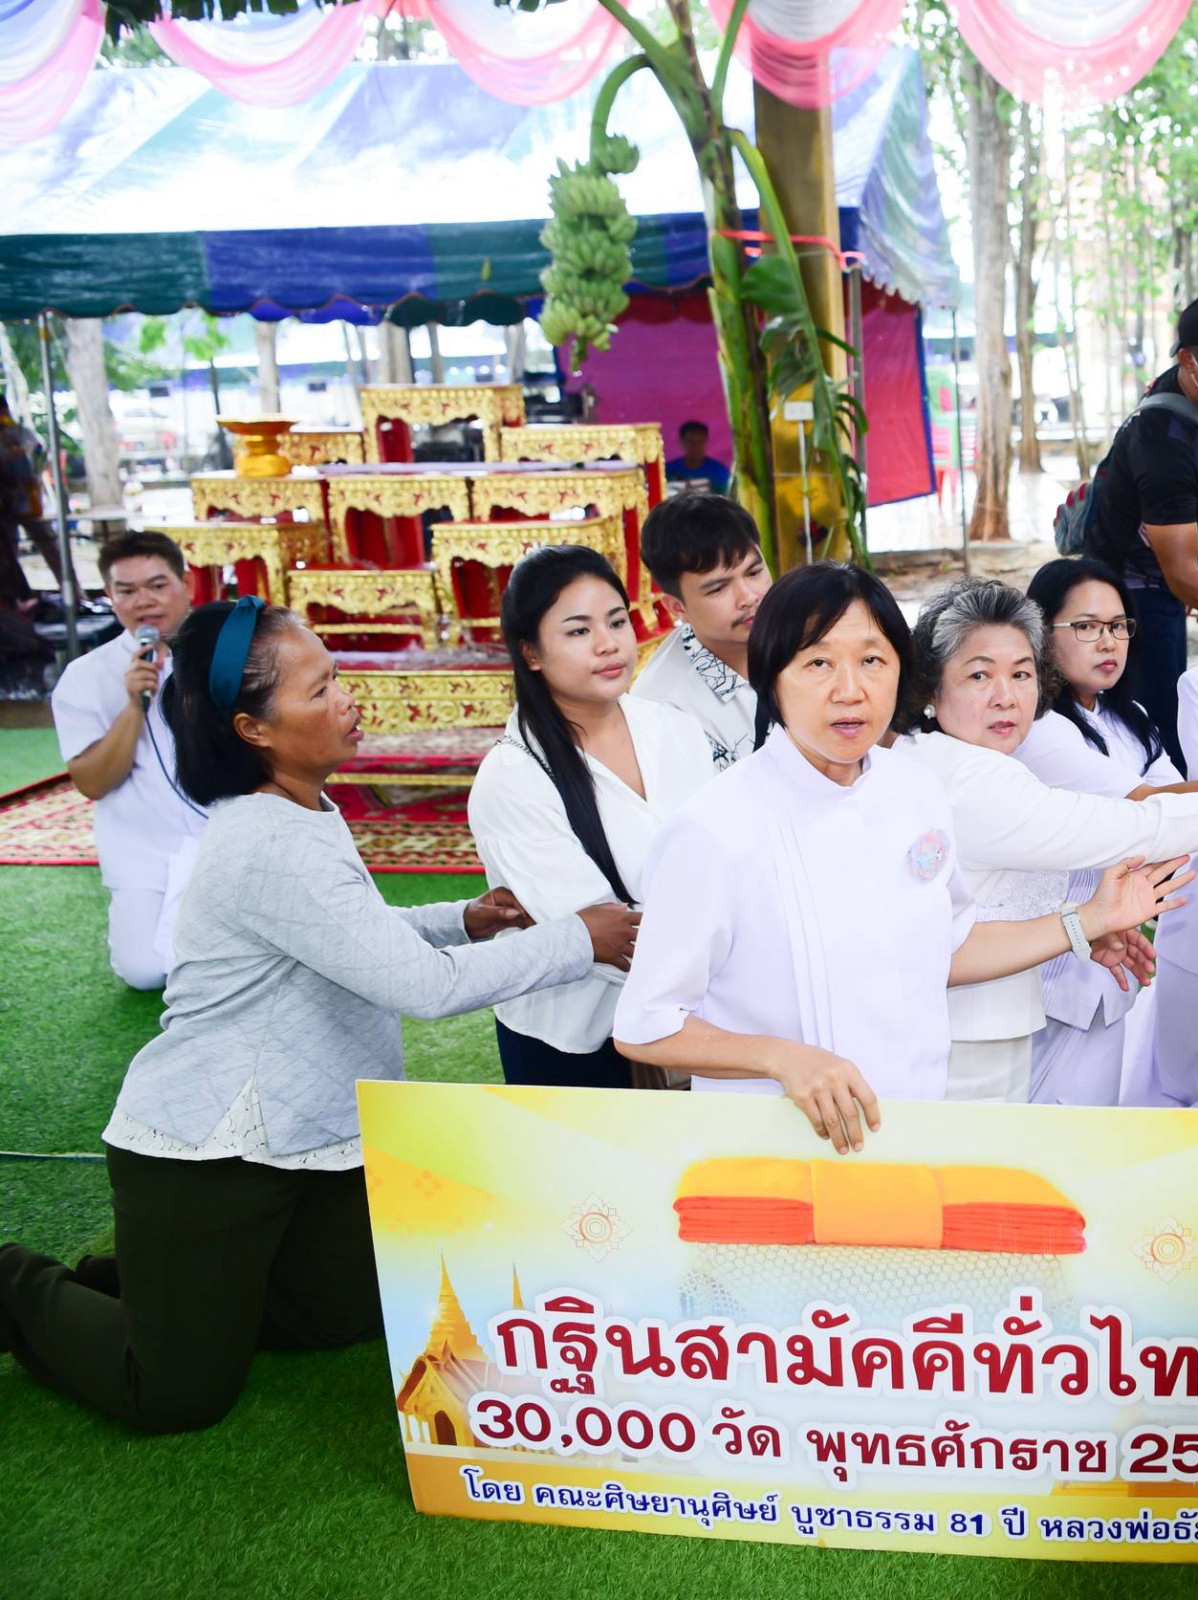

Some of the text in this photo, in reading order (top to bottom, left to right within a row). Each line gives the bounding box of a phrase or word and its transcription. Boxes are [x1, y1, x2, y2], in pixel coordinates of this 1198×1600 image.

[477, 1399, 696, 1453] 30,000
[712, 1406, 781, 1457] วัด
[806, 1419, 1107, 1482] พุทธศักราช
[463, 1468, 521, 1502] โดย
[536, 1483, 778, 1526] คณะศิษยานุศิษย์
[791, 1505, 935, 1535] บูชาธรรม
[949, 1513, 984, 1535] 81
[1001, 1507, 1026, 1537] ปี
